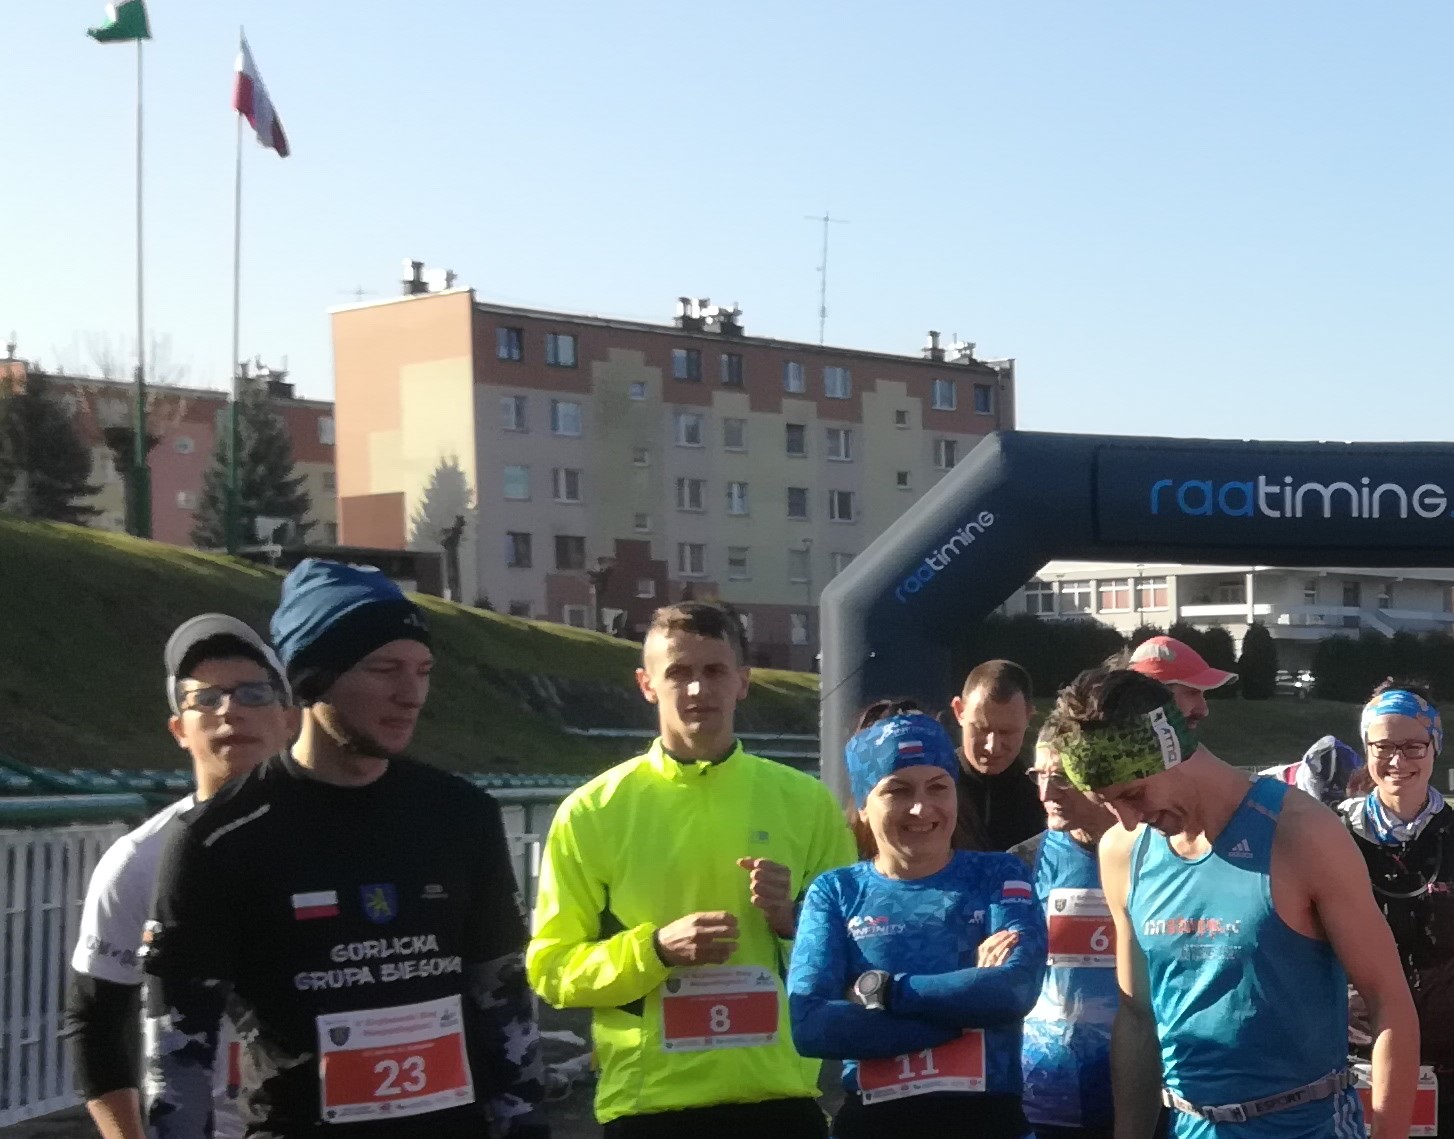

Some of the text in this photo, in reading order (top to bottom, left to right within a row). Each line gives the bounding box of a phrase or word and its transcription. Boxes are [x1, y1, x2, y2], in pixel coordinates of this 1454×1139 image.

[1090, 926, 1109, 952] 6
[293, 966, 376, 991] GRUPA
[710, 1004, 731, 1033] 8
[373, 1055, 428, 1097] 23
[895, 1048, 940, 1080] 11
